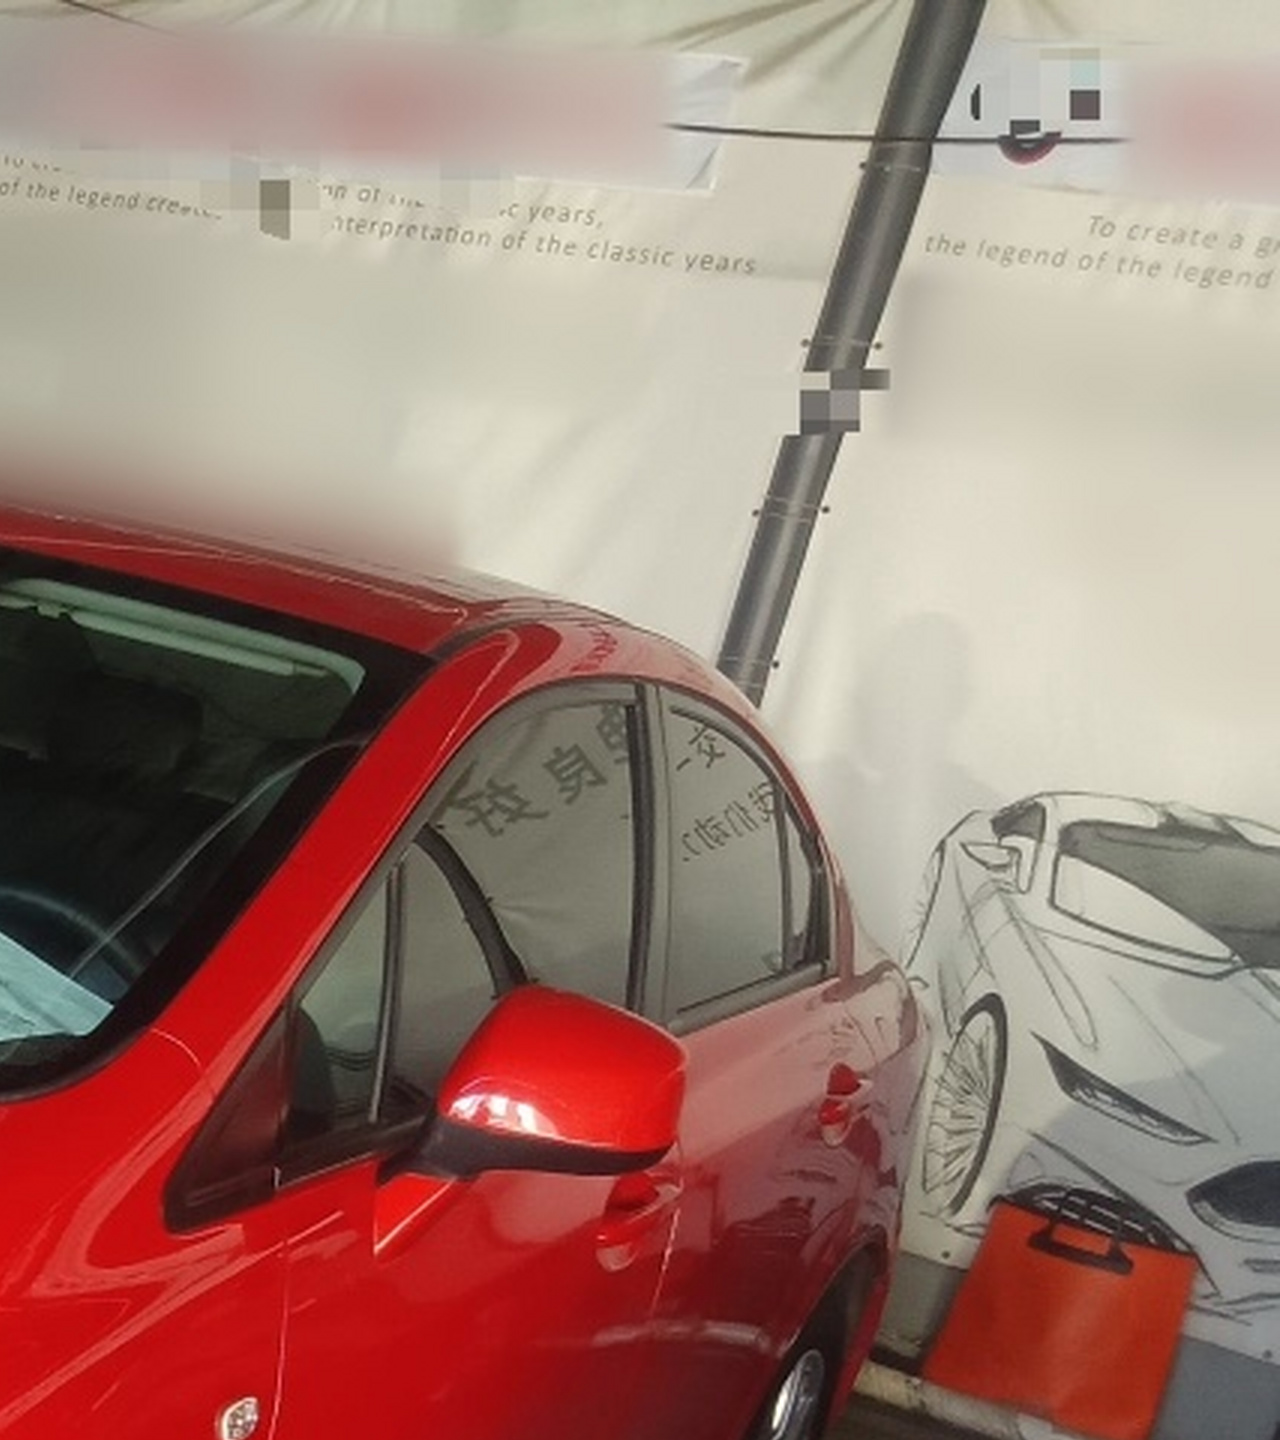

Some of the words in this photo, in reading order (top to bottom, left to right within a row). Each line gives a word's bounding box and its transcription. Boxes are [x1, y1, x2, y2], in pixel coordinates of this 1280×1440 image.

[26, 182, 60, 202] the
[66, 184, 142, 211] legend
[529, 202, 603, 230] years,
[1089, 215, 1117, 239] To
[1127, 223, 1219, 250] create
[1229, 232, 1245, 251] a
[501, 229, 528, 251] of
[536, 233, 577, 257] the
[588, 240, 676, 268] classic
[685, 253, 757, 276] years
[925, 234, 967, 258] the
[978, 239, 1069, 269] legend
[1078, 251, 1109, 272] of
[1117, 255, 1162, 280] the
[1174, 258, 1274, 290] legend
